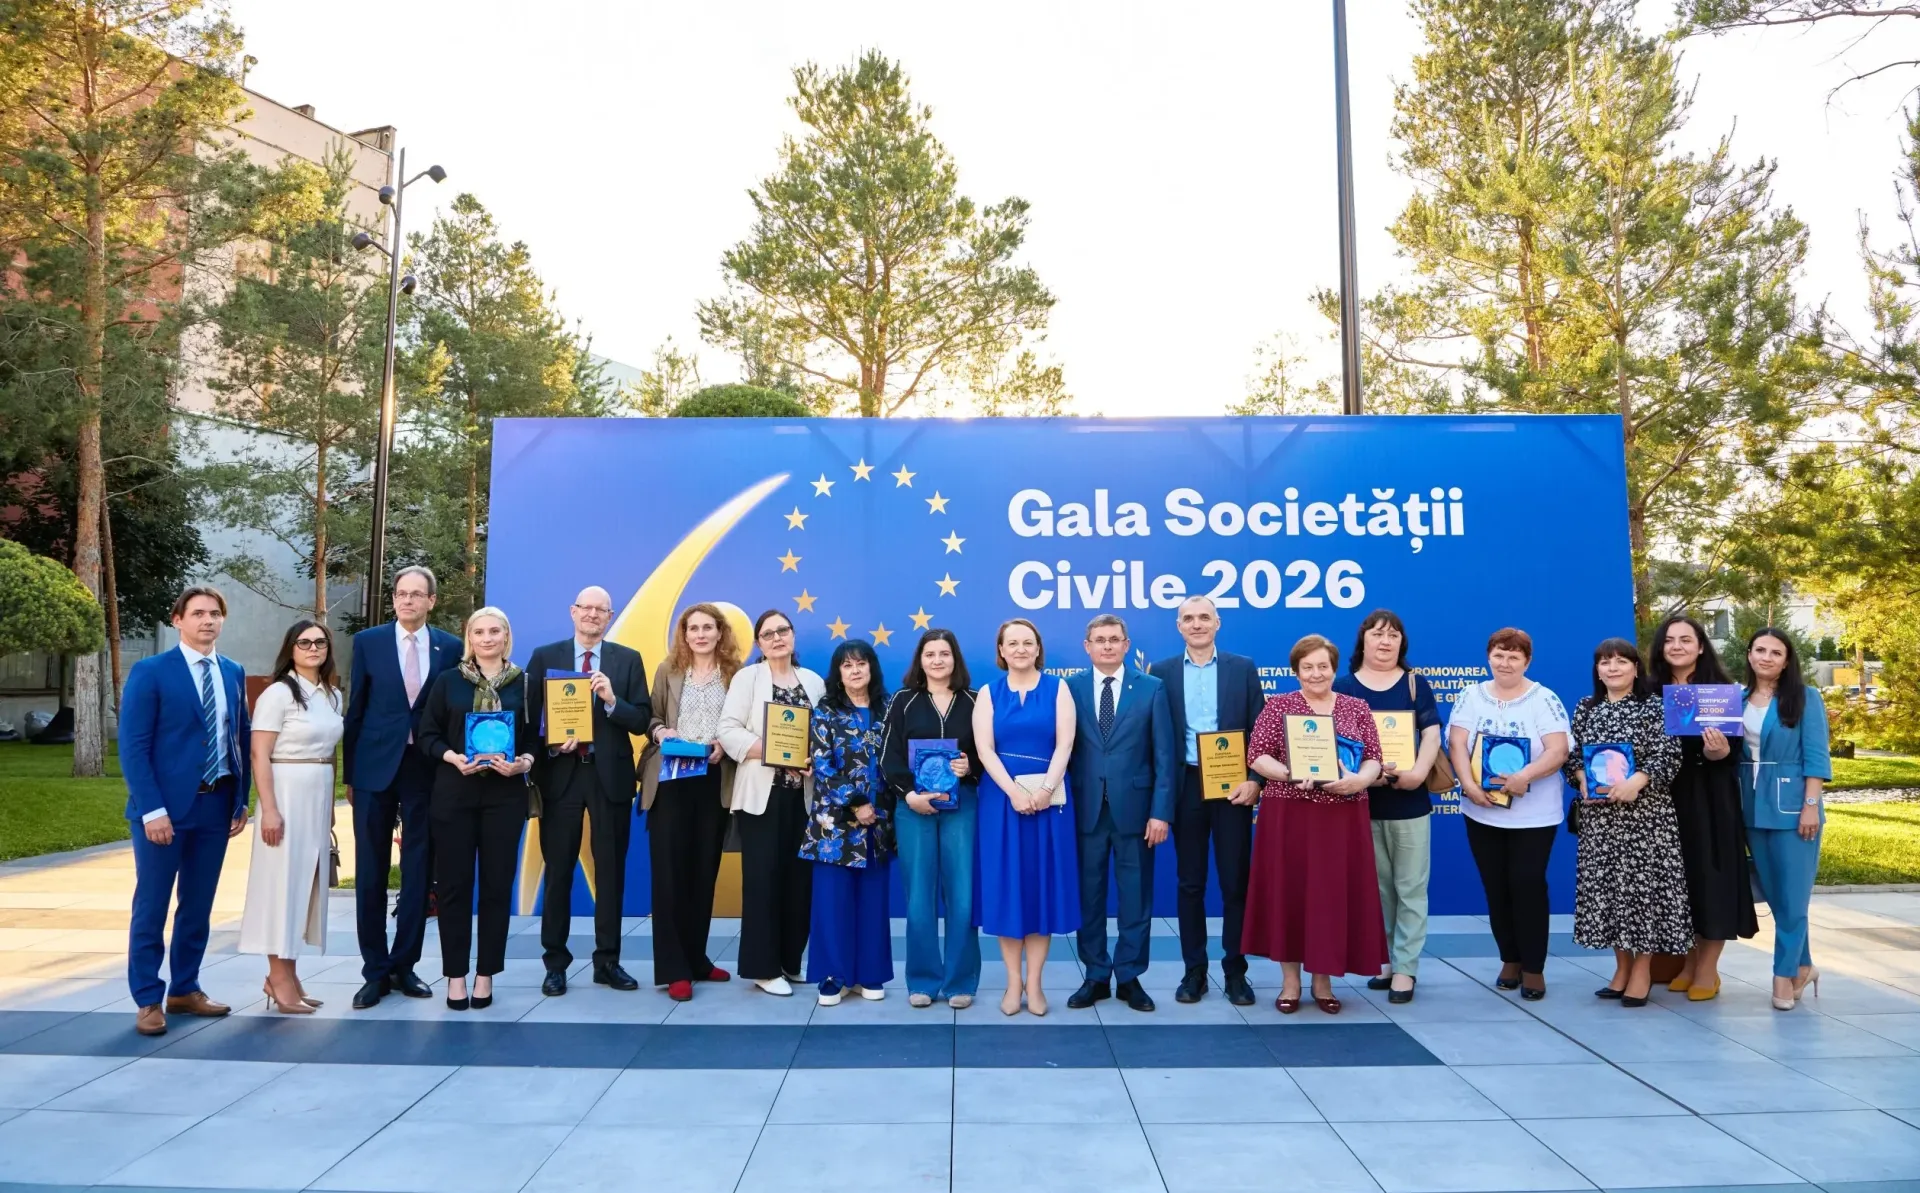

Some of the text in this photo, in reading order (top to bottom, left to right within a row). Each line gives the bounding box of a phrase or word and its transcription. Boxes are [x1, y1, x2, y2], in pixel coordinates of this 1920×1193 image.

[1008, 487, 1464, 553] Gala Societății
[1008, 559, 1365, 609] Civile 2026
[1043, 668, 1088, 677] GUVE
[1256, 667, 1297, 677] IETATE
